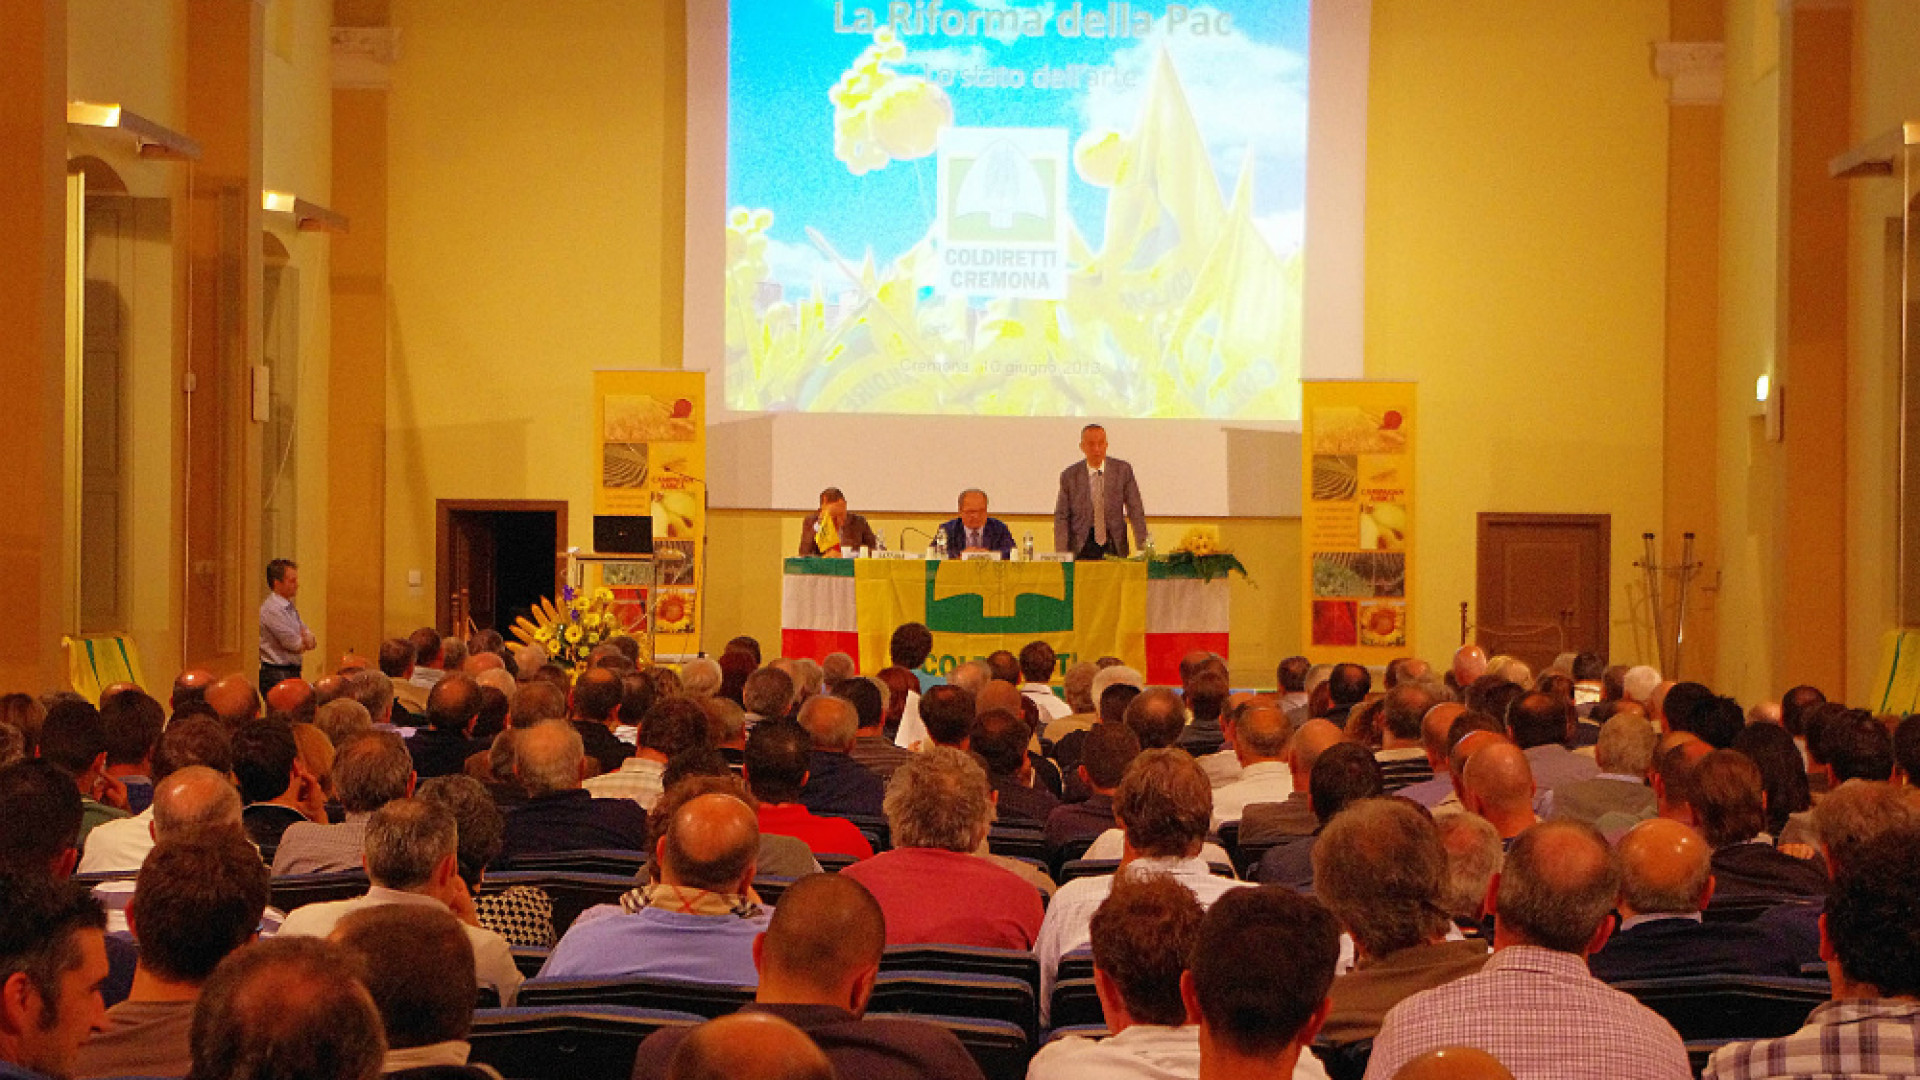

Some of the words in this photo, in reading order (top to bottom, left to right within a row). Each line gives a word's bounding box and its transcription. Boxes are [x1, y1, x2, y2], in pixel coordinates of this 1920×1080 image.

[834, 0, 874, 33] La
[887, 0, 1045, 37] Riforma
[1057, 0, 1152, 38] della
[1166, 3, 1231, 37] Pac
[925, 63, 954, 87] Lo
[960, 64, 1025, 88] stato
[944, 248, 1058, 268] COLDIRETTI
[950, 270, 1050, 289] CREMONA
[900, 358, 969, 373] Cremona
[1005, 359, 1057, 376] giugno
[1063, 359, 1103, 375] 2013
